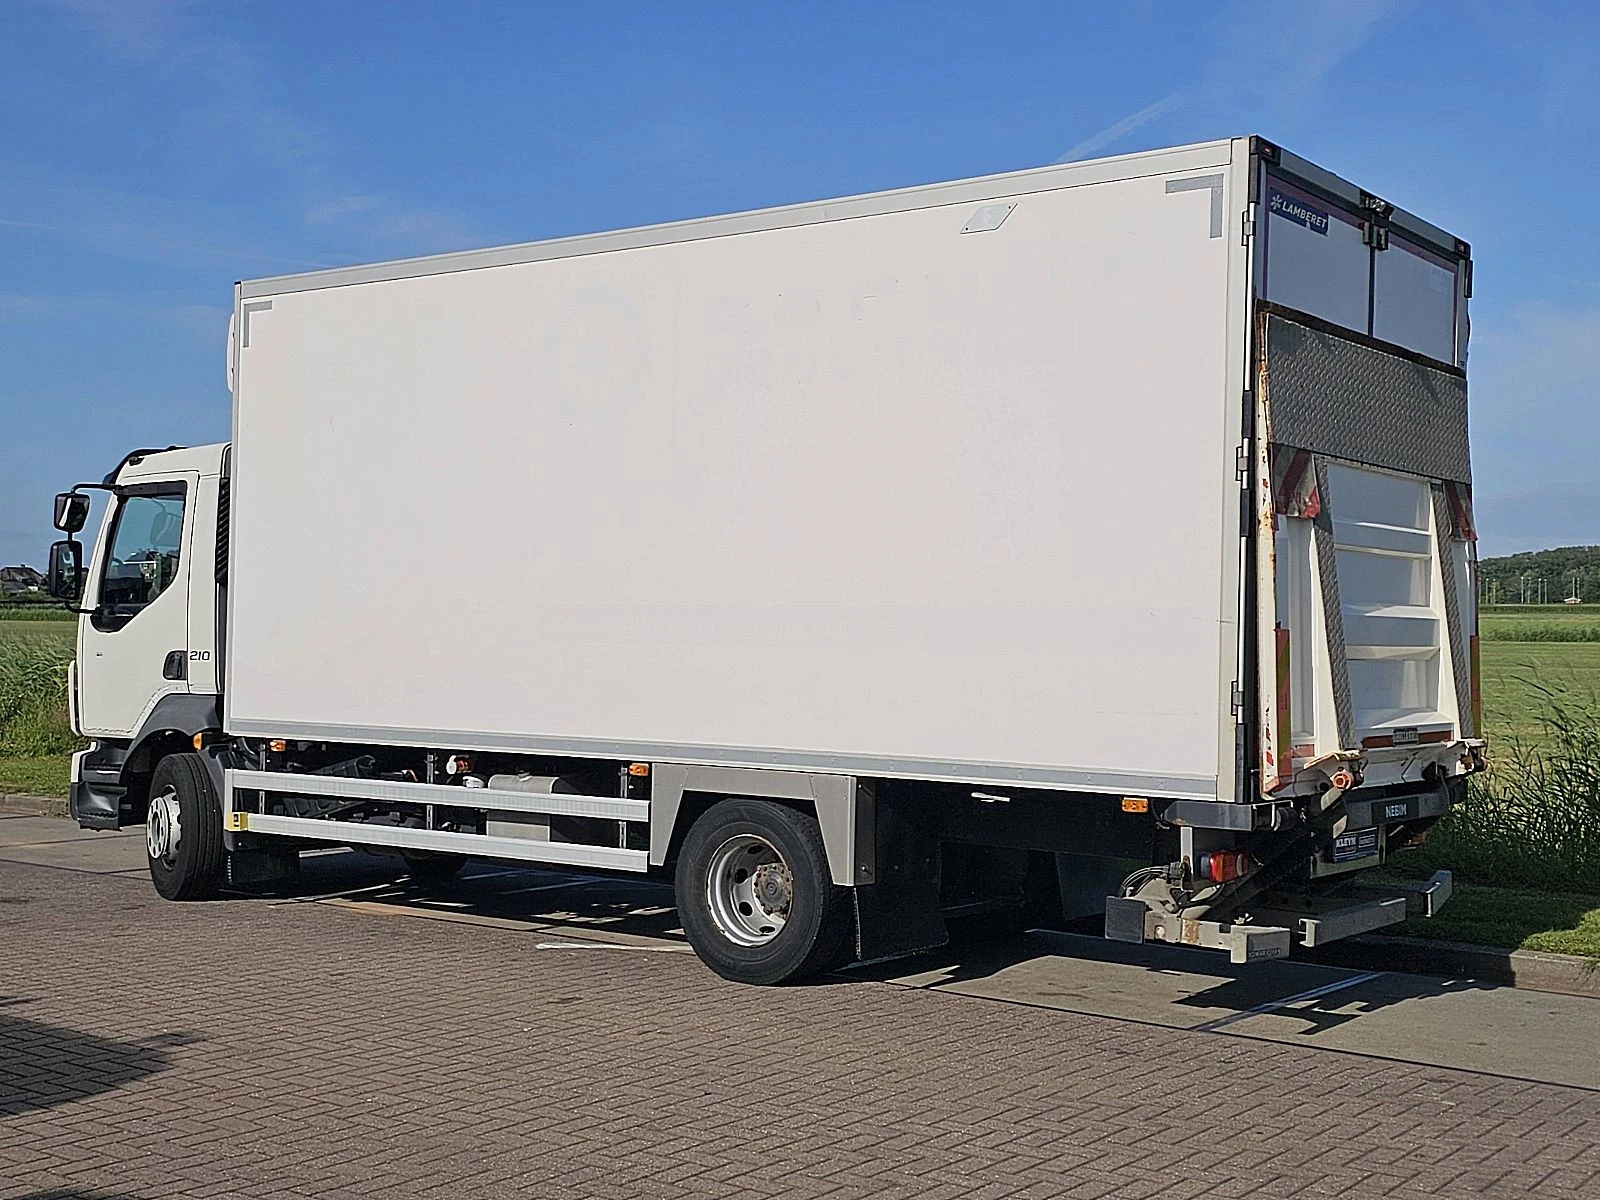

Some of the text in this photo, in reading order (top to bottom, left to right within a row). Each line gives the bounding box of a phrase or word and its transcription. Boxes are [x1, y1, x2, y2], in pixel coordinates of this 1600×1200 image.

[1281, 201, 1328, 228] LAMBERET
[189, 650, 211, 661] 210
[1385, 803, 1407, 818] NEBIM
[1336, 836, 1356, 848] KLEYN
